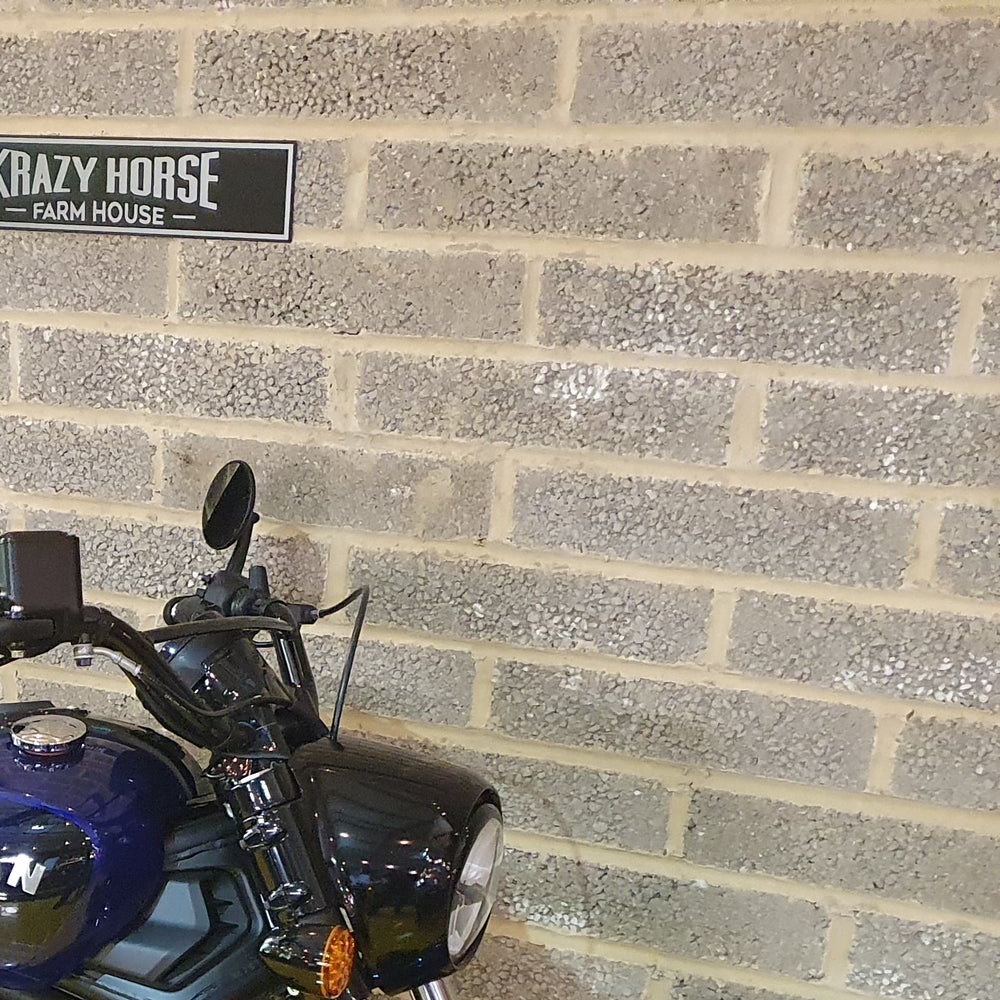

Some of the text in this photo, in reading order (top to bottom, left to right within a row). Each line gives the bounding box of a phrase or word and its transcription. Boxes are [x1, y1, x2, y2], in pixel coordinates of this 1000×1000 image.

[106, 151, 220, 211] HORSE
[32, 200, 165, 226] FARM HOUSE
